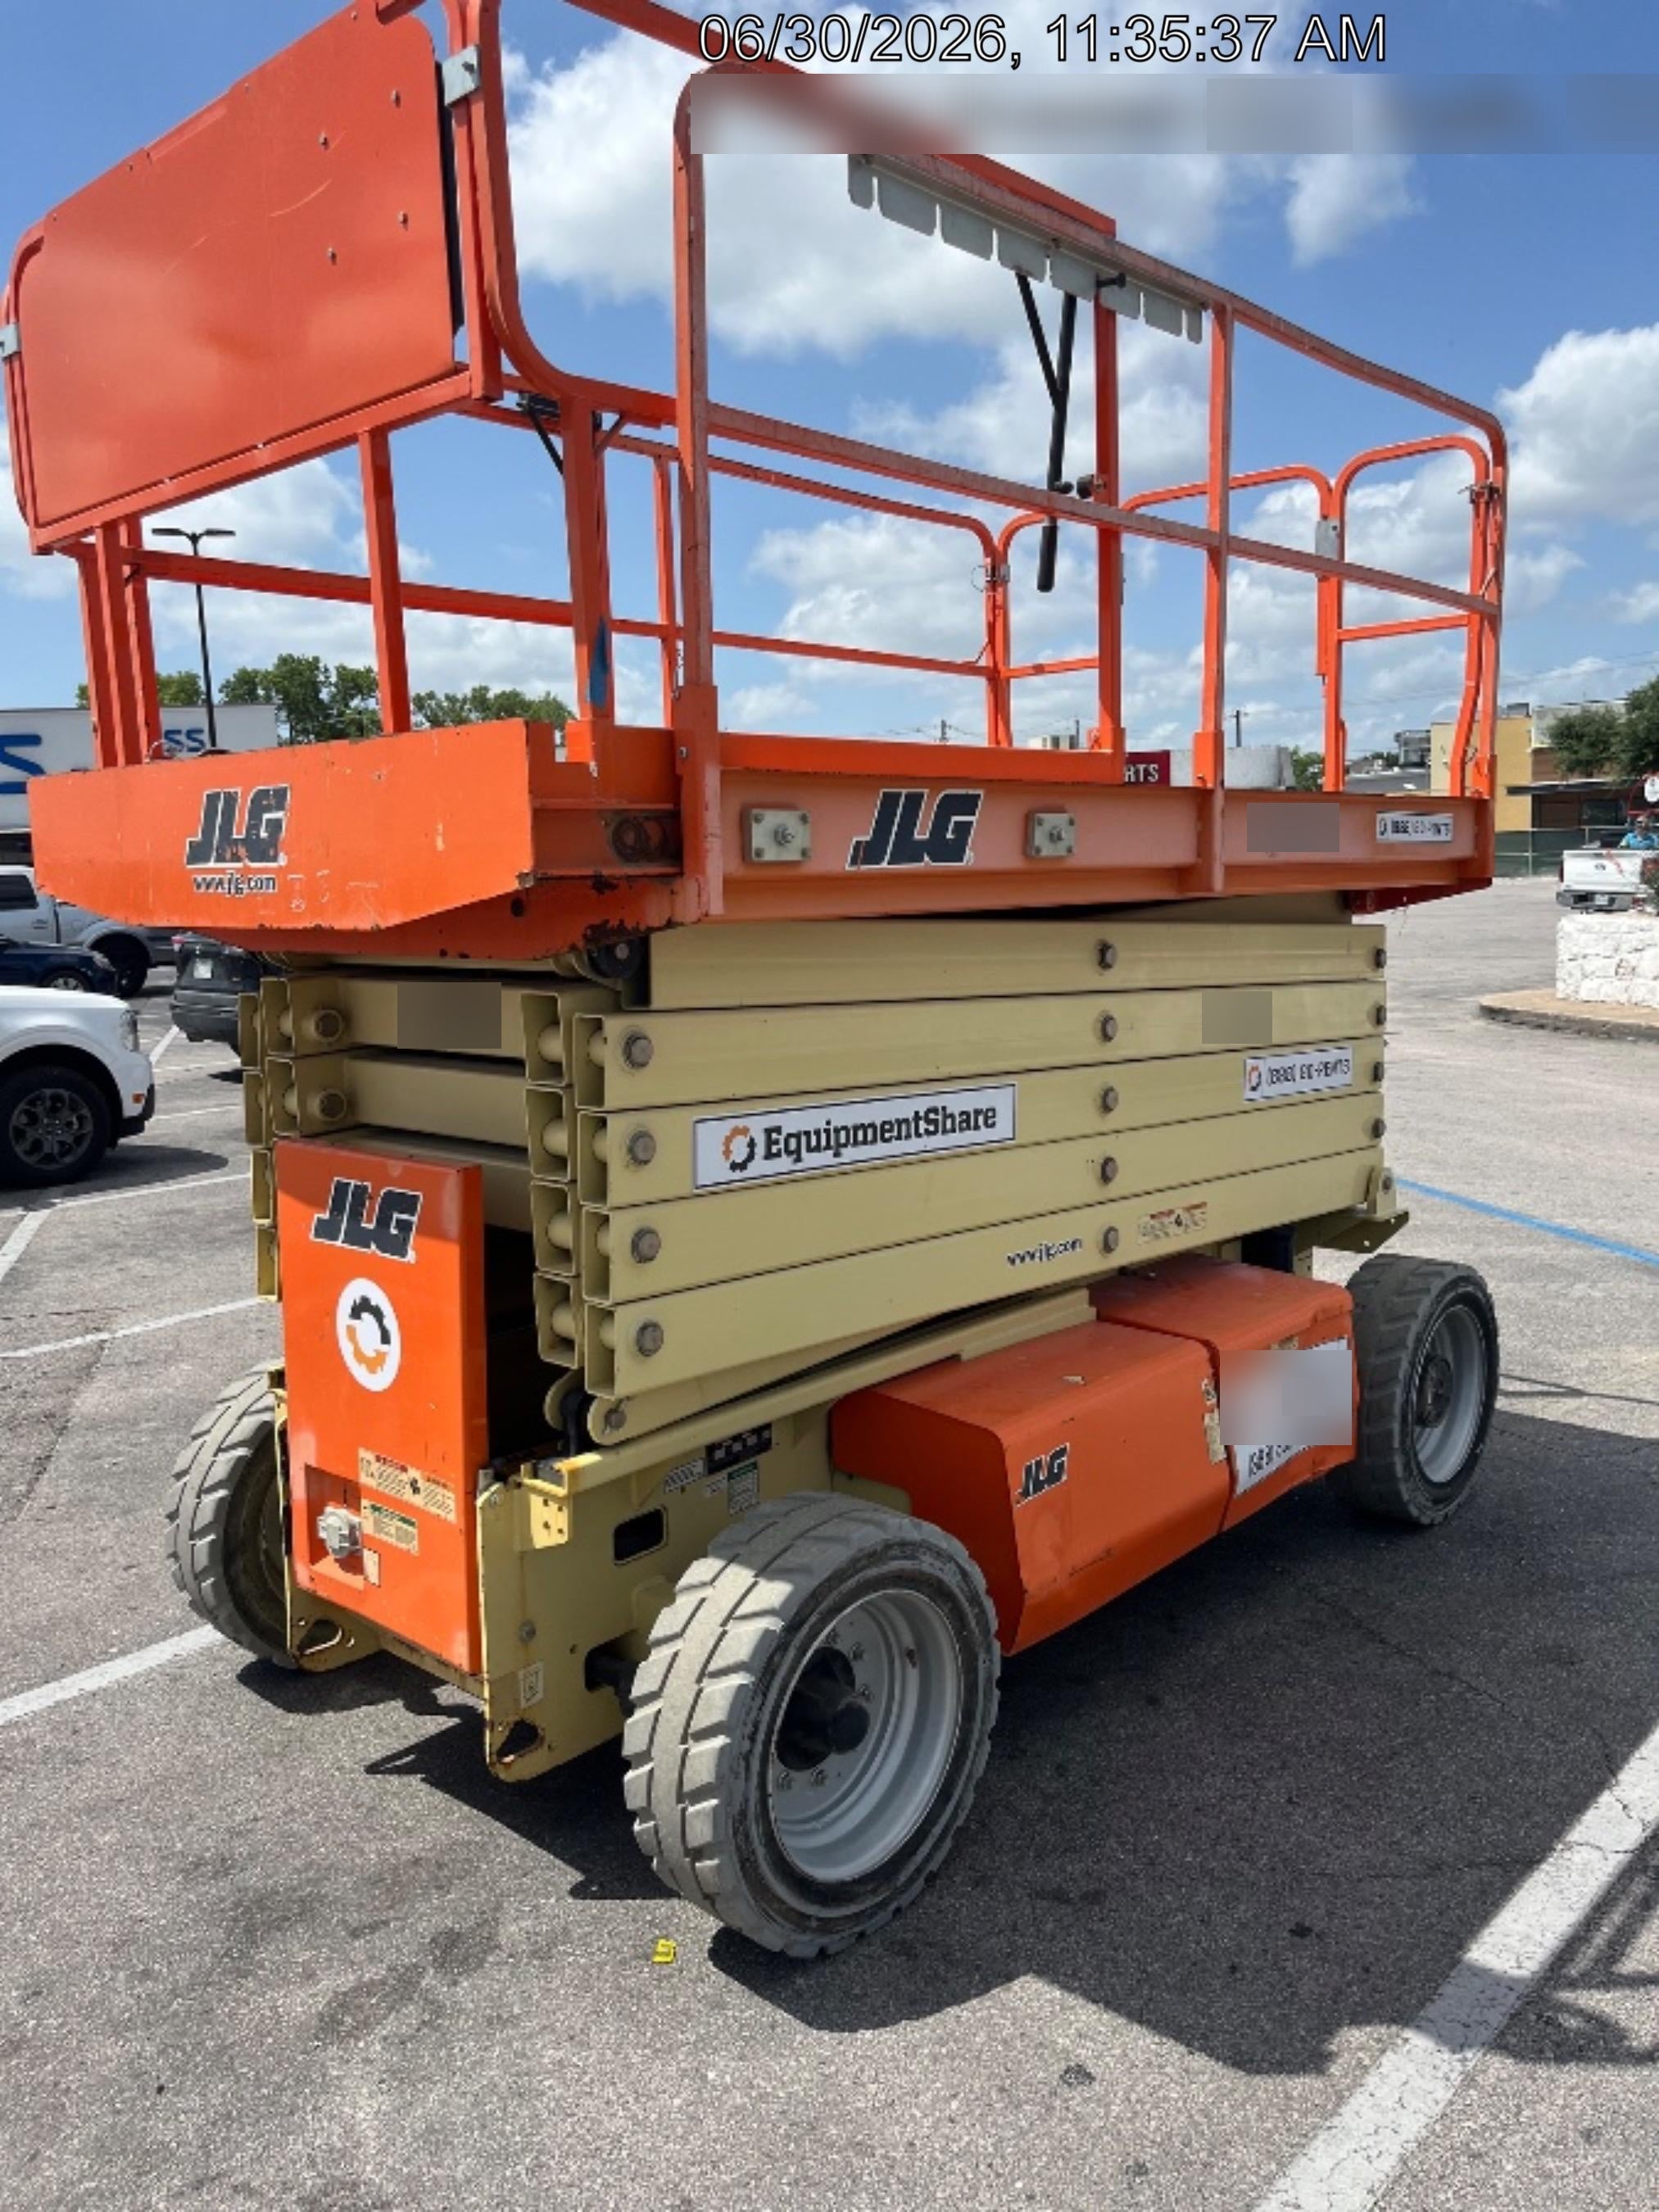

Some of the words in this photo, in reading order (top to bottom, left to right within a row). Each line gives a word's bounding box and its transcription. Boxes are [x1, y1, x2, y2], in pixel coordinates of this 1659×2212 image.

[1125, 763, 1159, 783] RTS
[184, 784, 291, 869] JLG
[845, 788, 985, 870] JLG
[763, 1106, 996, 1164] EquipmentShare
[309, 1176, 424, 1263] JLG
[1015, 1442, 1070, 1507] JLG
